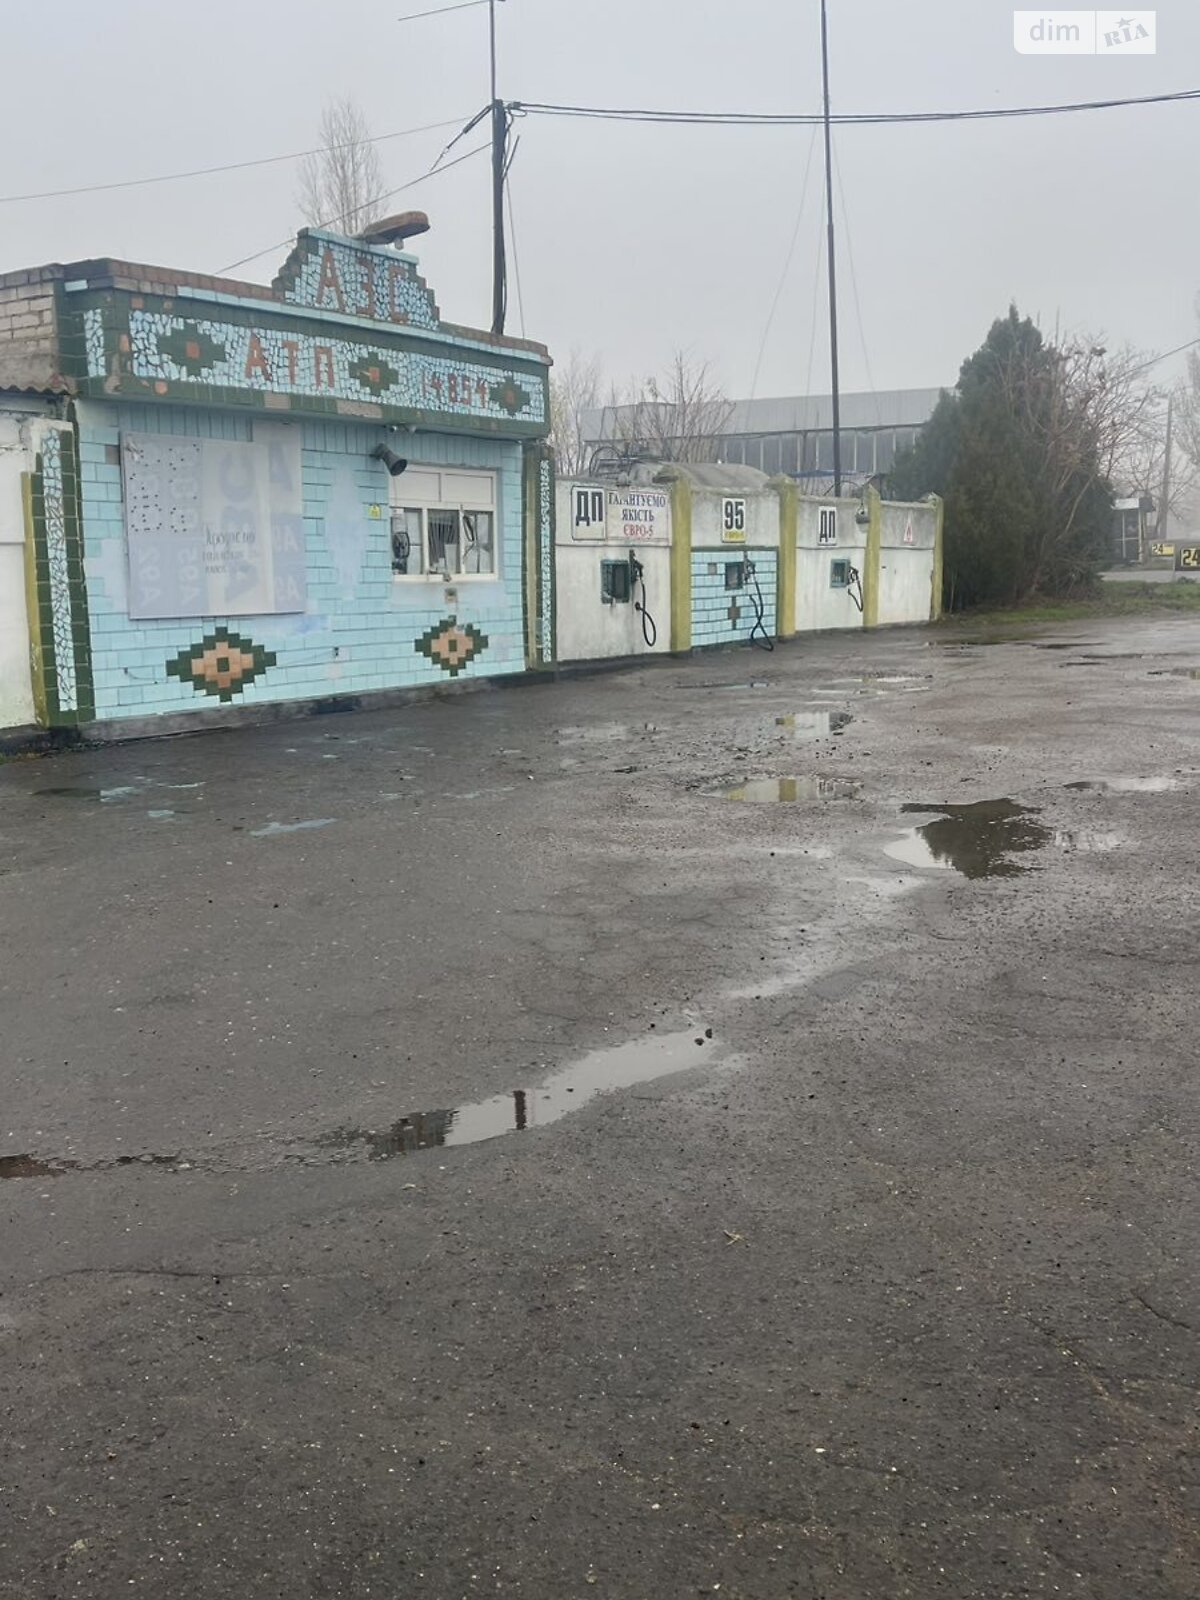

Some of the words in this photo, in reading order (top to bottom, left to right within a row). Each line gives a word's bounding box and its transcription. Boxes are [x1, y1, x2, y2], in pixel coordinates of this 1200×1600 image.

[315, 248, 410, 324] АЗС
[244, 333, 335, 390] АТП
[575, 490, 604, 527] ДП
[608, 492, 666, 508] ГААНТУЄМО
[622, 508, 655, 522] ЯКІСТЬ
[724, 500, 745, 530] 95
[623, 524, 654, 537] ЄВРО-5
[819, 510, 836, 543] ДП
